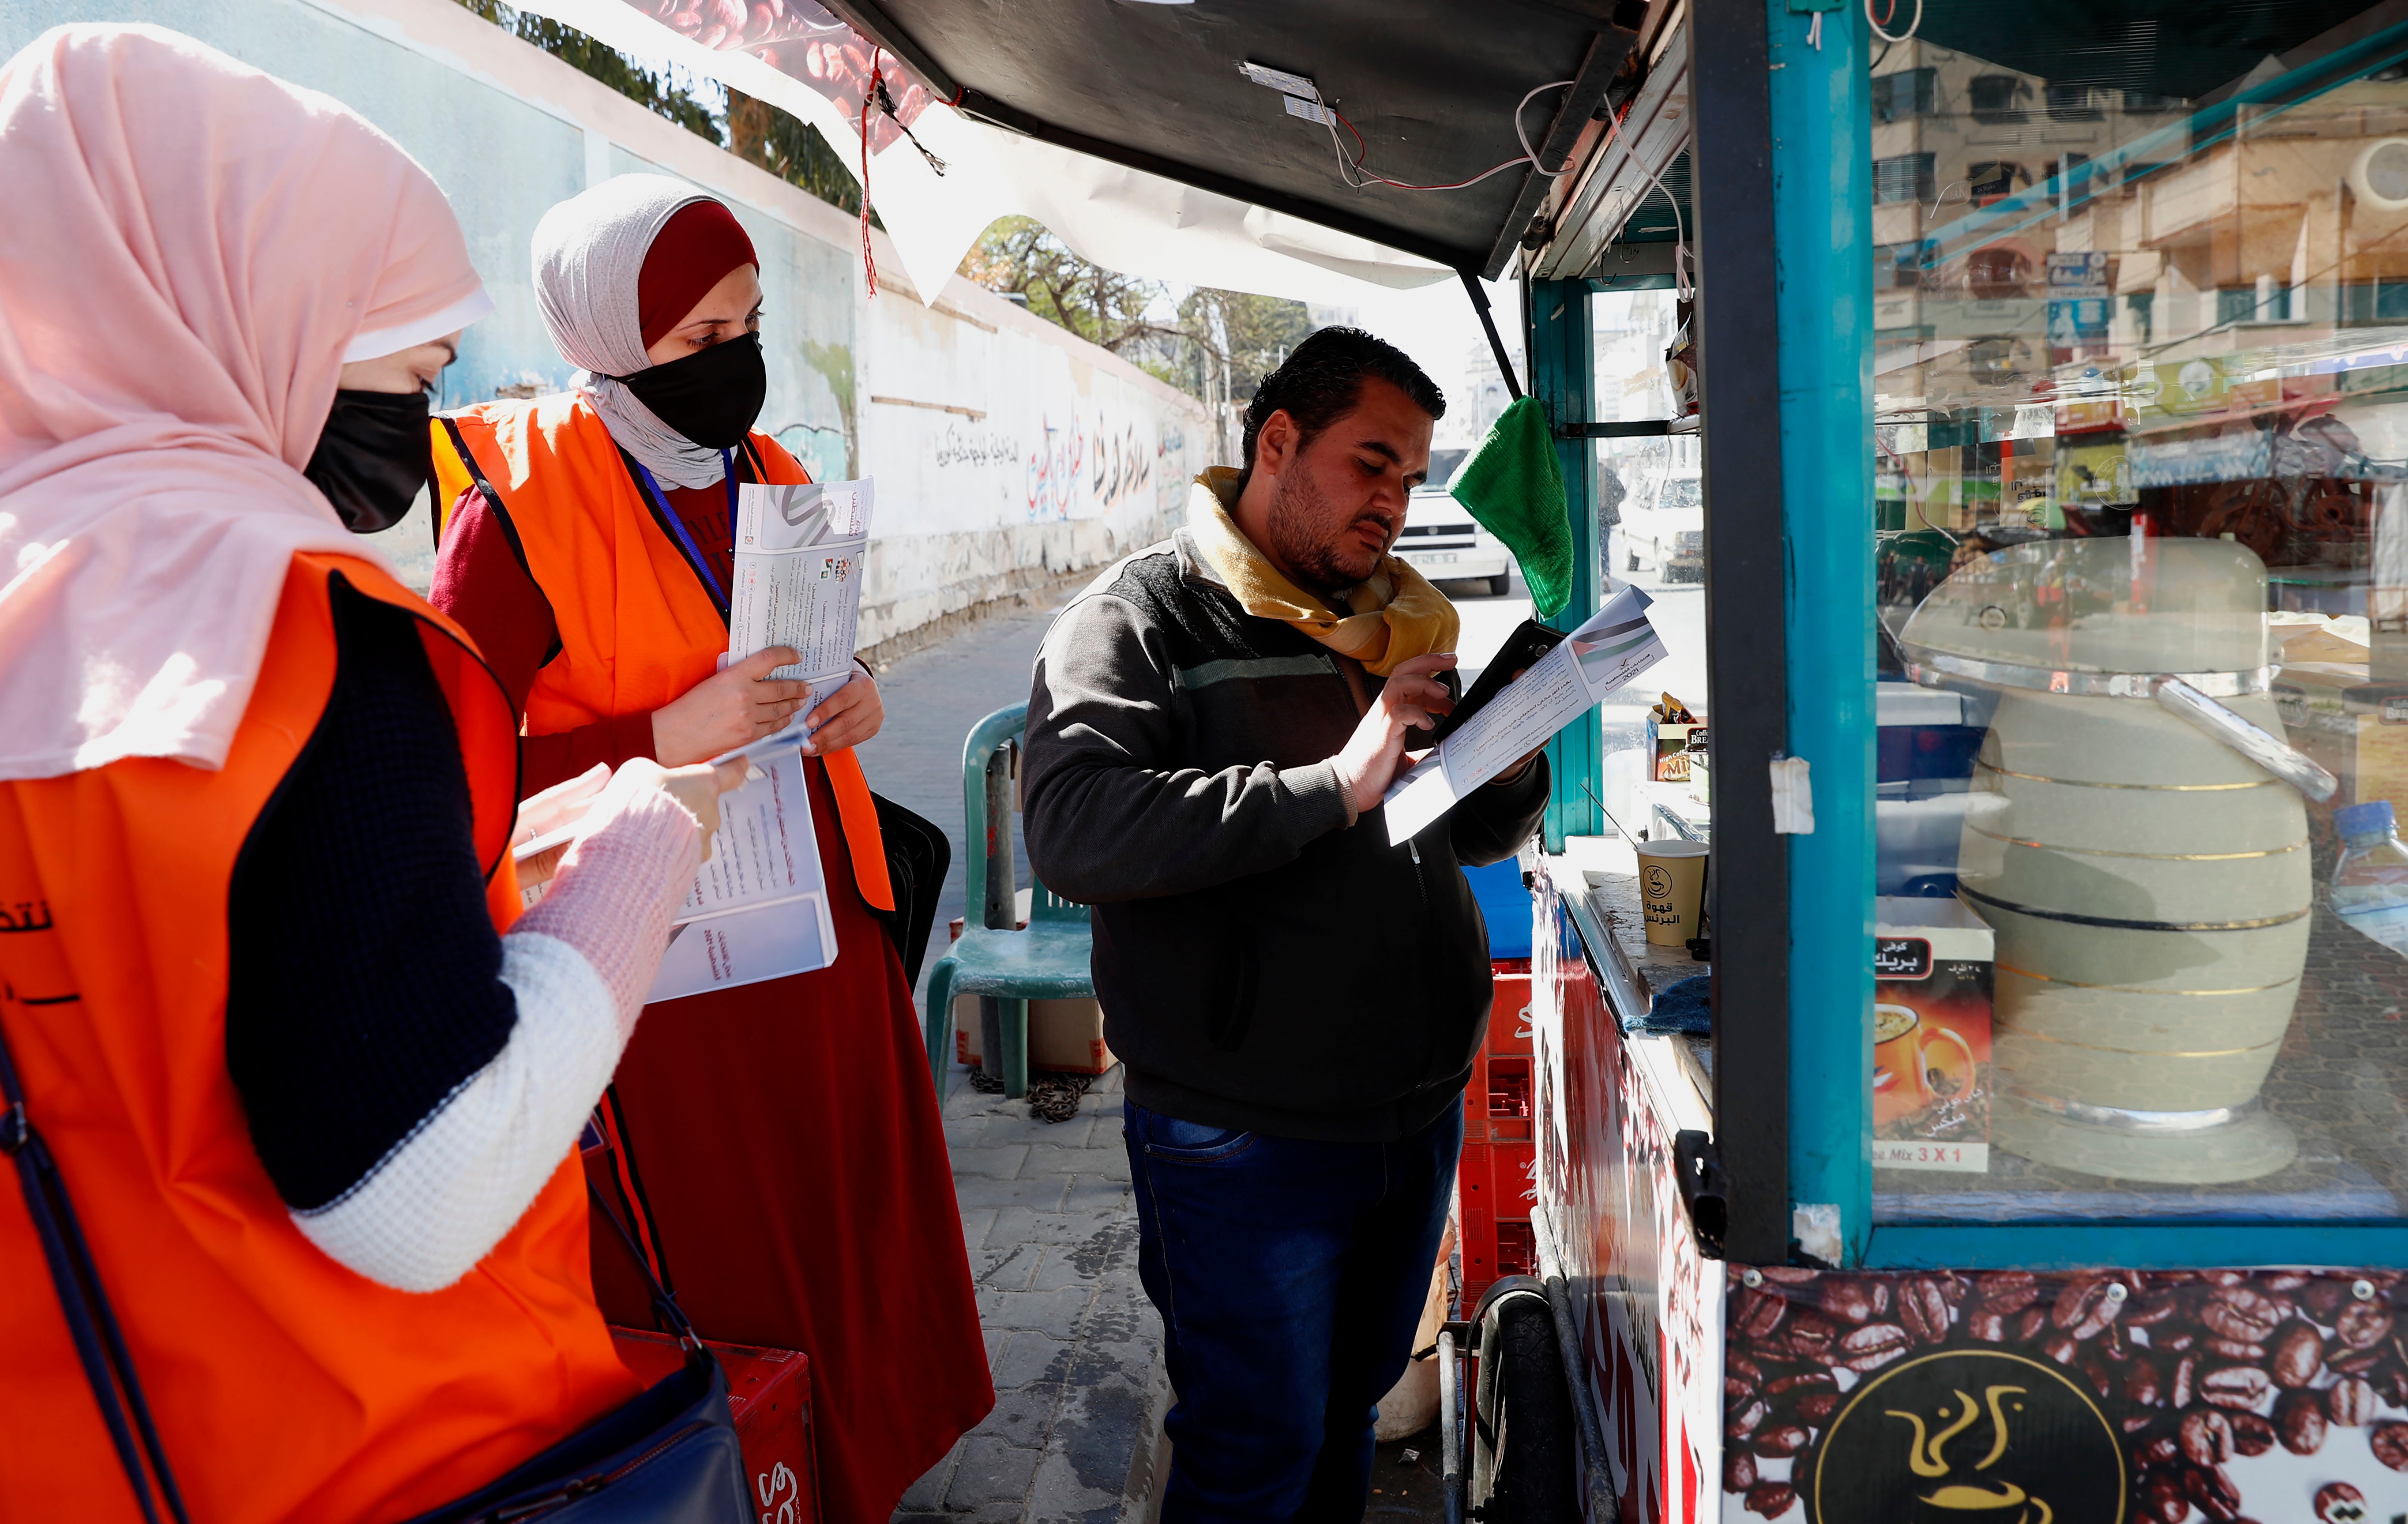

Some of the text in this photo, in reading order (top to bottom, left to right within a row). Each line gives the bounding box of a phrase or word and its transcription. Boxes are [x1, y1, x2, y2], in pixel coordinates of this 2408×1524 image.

[1604, 653, 1650, 686] الانتخابات الفلسطينية
[1621, 667, 1639, 681] 2021
[1691, 735, 1708, 744] BRE
[1659, 754, 1673, 764] High
[1646, 900, 1673, 914] قهوة
[1644, 914, 1680, 925] البرنس
[1890, 1148, 1913, 1161] Mix
[1918, 1147, 1929, 1162] 3
[1933, 1147, 1946, 1162] X
[1952, 1148, 1962, 1163] 1
